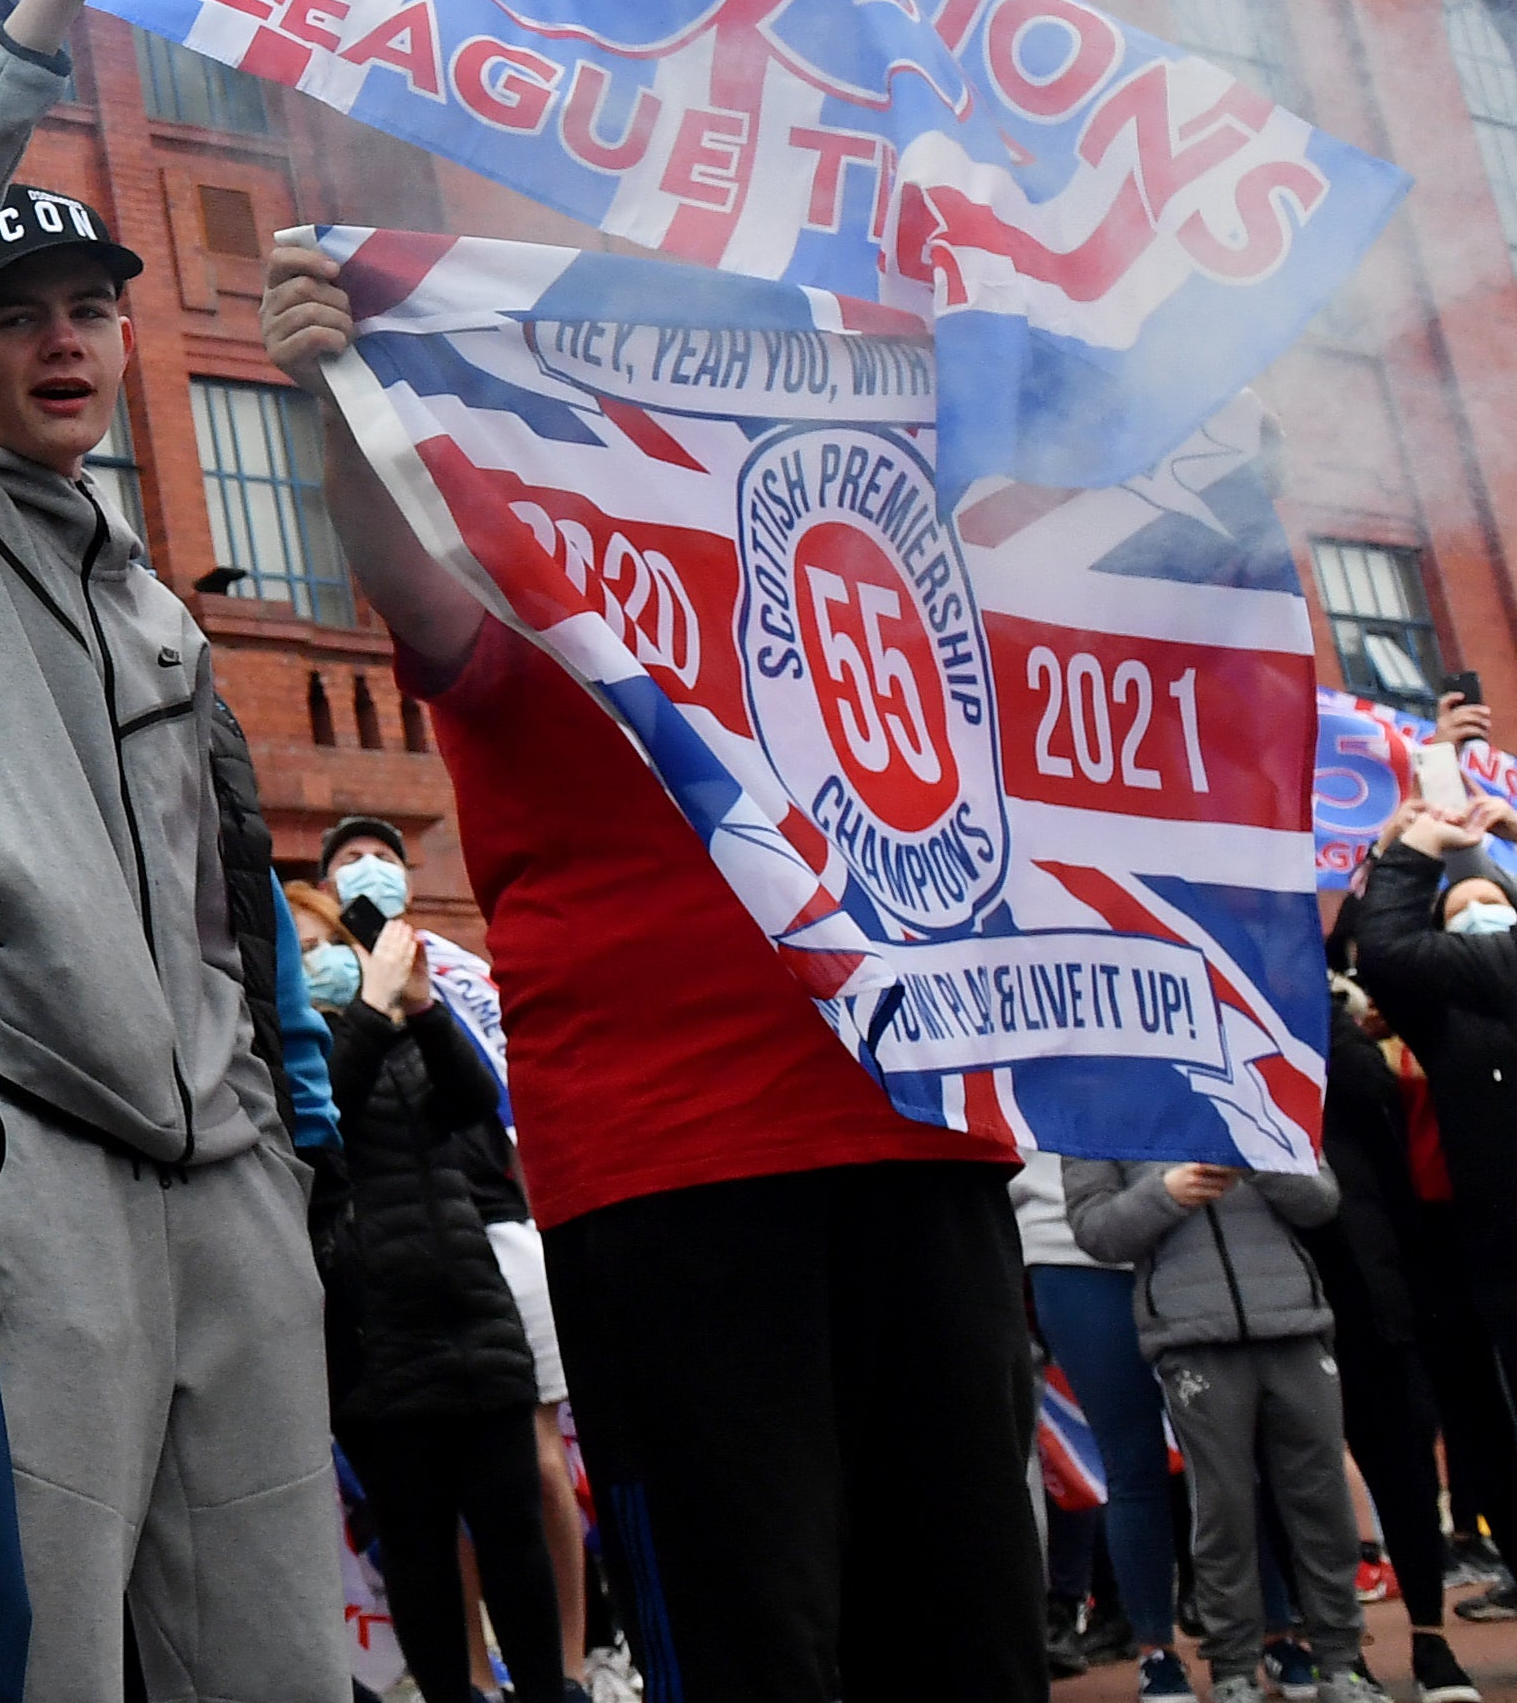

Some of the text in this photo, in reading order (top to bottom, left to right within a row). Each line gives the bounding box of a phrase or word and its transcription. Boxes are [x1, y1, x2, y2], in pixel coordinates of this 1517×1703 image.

[651, 327, 752, 390] YEAH
[765, 329, 839, 403] YOU,
[750, 443, 982, 726] SCOTTISH PREMIERSHIP
[804, 564, 942, 785] 55
[1026, 645, 1209, 794] 2021
[811, 774, 995, 912] CHAMPIONS
[993, 964, 1018, 1033] &
[1015, 963, 1086, 1030] LIVE
[1090, 963, 1123, 1030] IT
[1131, 967, 1198, 1039] UP!
